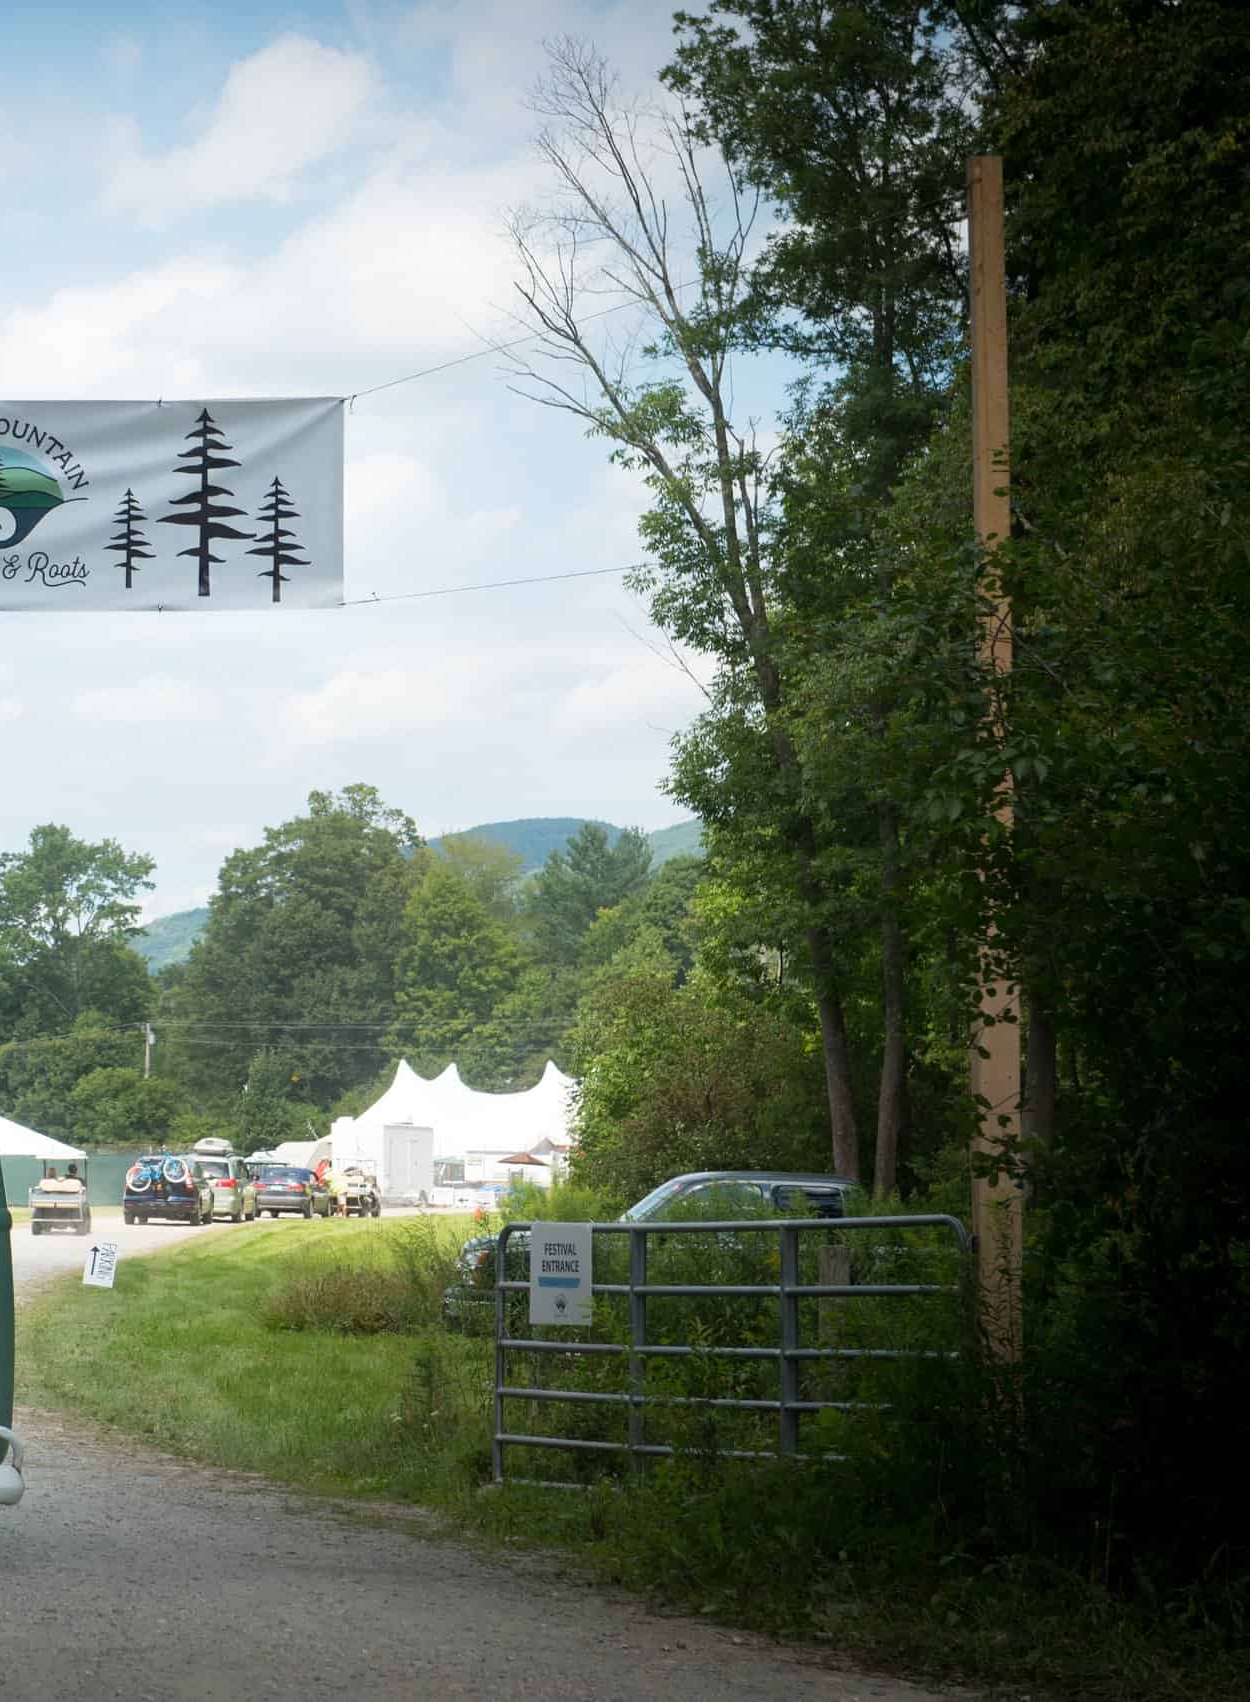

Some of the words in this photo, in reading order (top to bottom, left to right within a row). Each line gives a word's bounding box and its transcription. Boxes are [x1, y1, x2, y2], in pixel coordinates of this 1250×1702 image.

[2, 554, 22, 580] &
[24, 551, 91, 588] Roots
[543, 1242, 578, 1257] FESTIVAL
[541, 1259, 581, 1273] ENTRANCE
